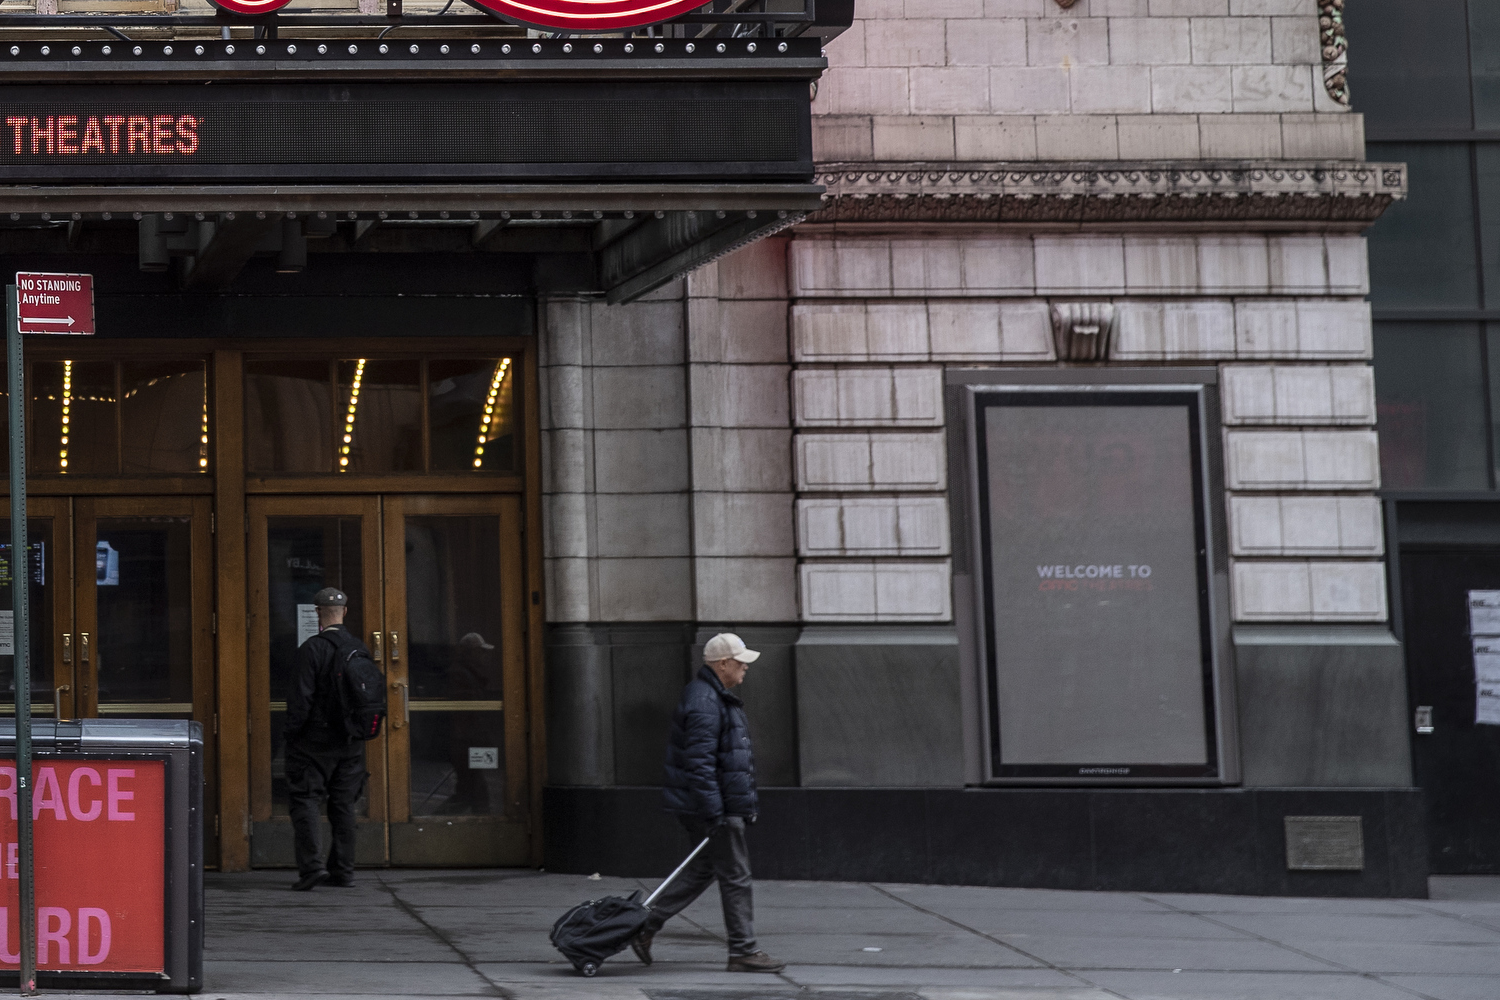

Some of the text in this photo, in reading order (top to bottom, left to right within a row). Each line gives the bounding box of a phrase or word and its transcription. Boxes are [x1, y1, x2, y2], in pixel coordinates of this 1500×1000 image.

[6, 114, 199, 157] THEATRES
[21, 279, 82, 292] NO STANDING
[22, 292, 61, 307] Anytime
[1036, 564, 1152, 579] WELCOME TO
